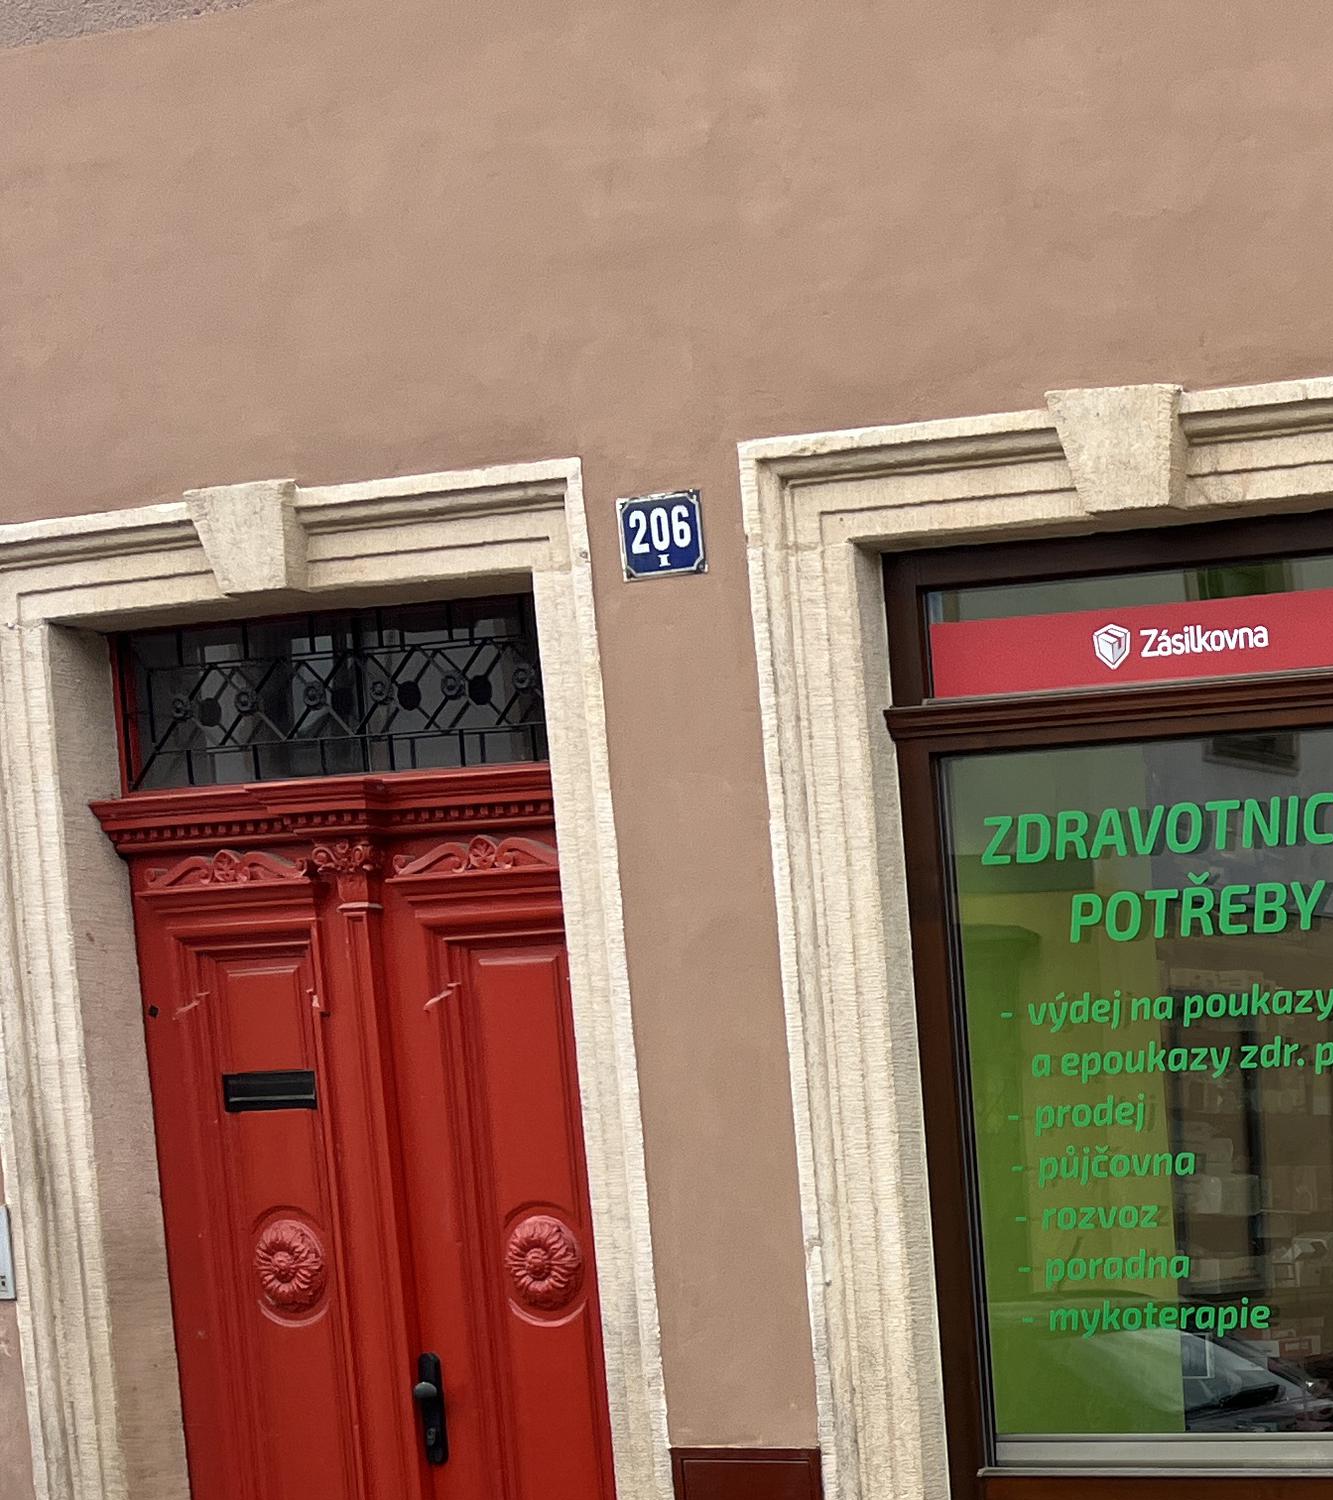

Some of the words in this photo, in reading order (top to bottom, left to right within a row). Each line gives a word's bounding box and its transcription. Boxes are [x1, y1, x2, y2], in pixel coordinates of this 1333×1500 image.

[629, 505, 691, 554] 206
[1140, 625, 1270, 659] Zásilkovna
[1070, 872, 1326, 943] POTŘEBY
[1028, 989, 1121, 1032] výdej
[1131, 994, 1173, 1023] na
[1032, 1054, 1051, 1078] a
[1061, 1039, 1231, 1083] epoukazy
[1240, 1036, 1305, 1070] zdr.
[1035, 1093, 1145, 1136] prodej
[1038, 1146, 1195, 1187] půjčovna
[1041, 1203, 1158, 1231] rozvoz
[1045, 1249, 1190, 1288] poradna
[1049, 1297, 1271, 1339] mykoterapie
